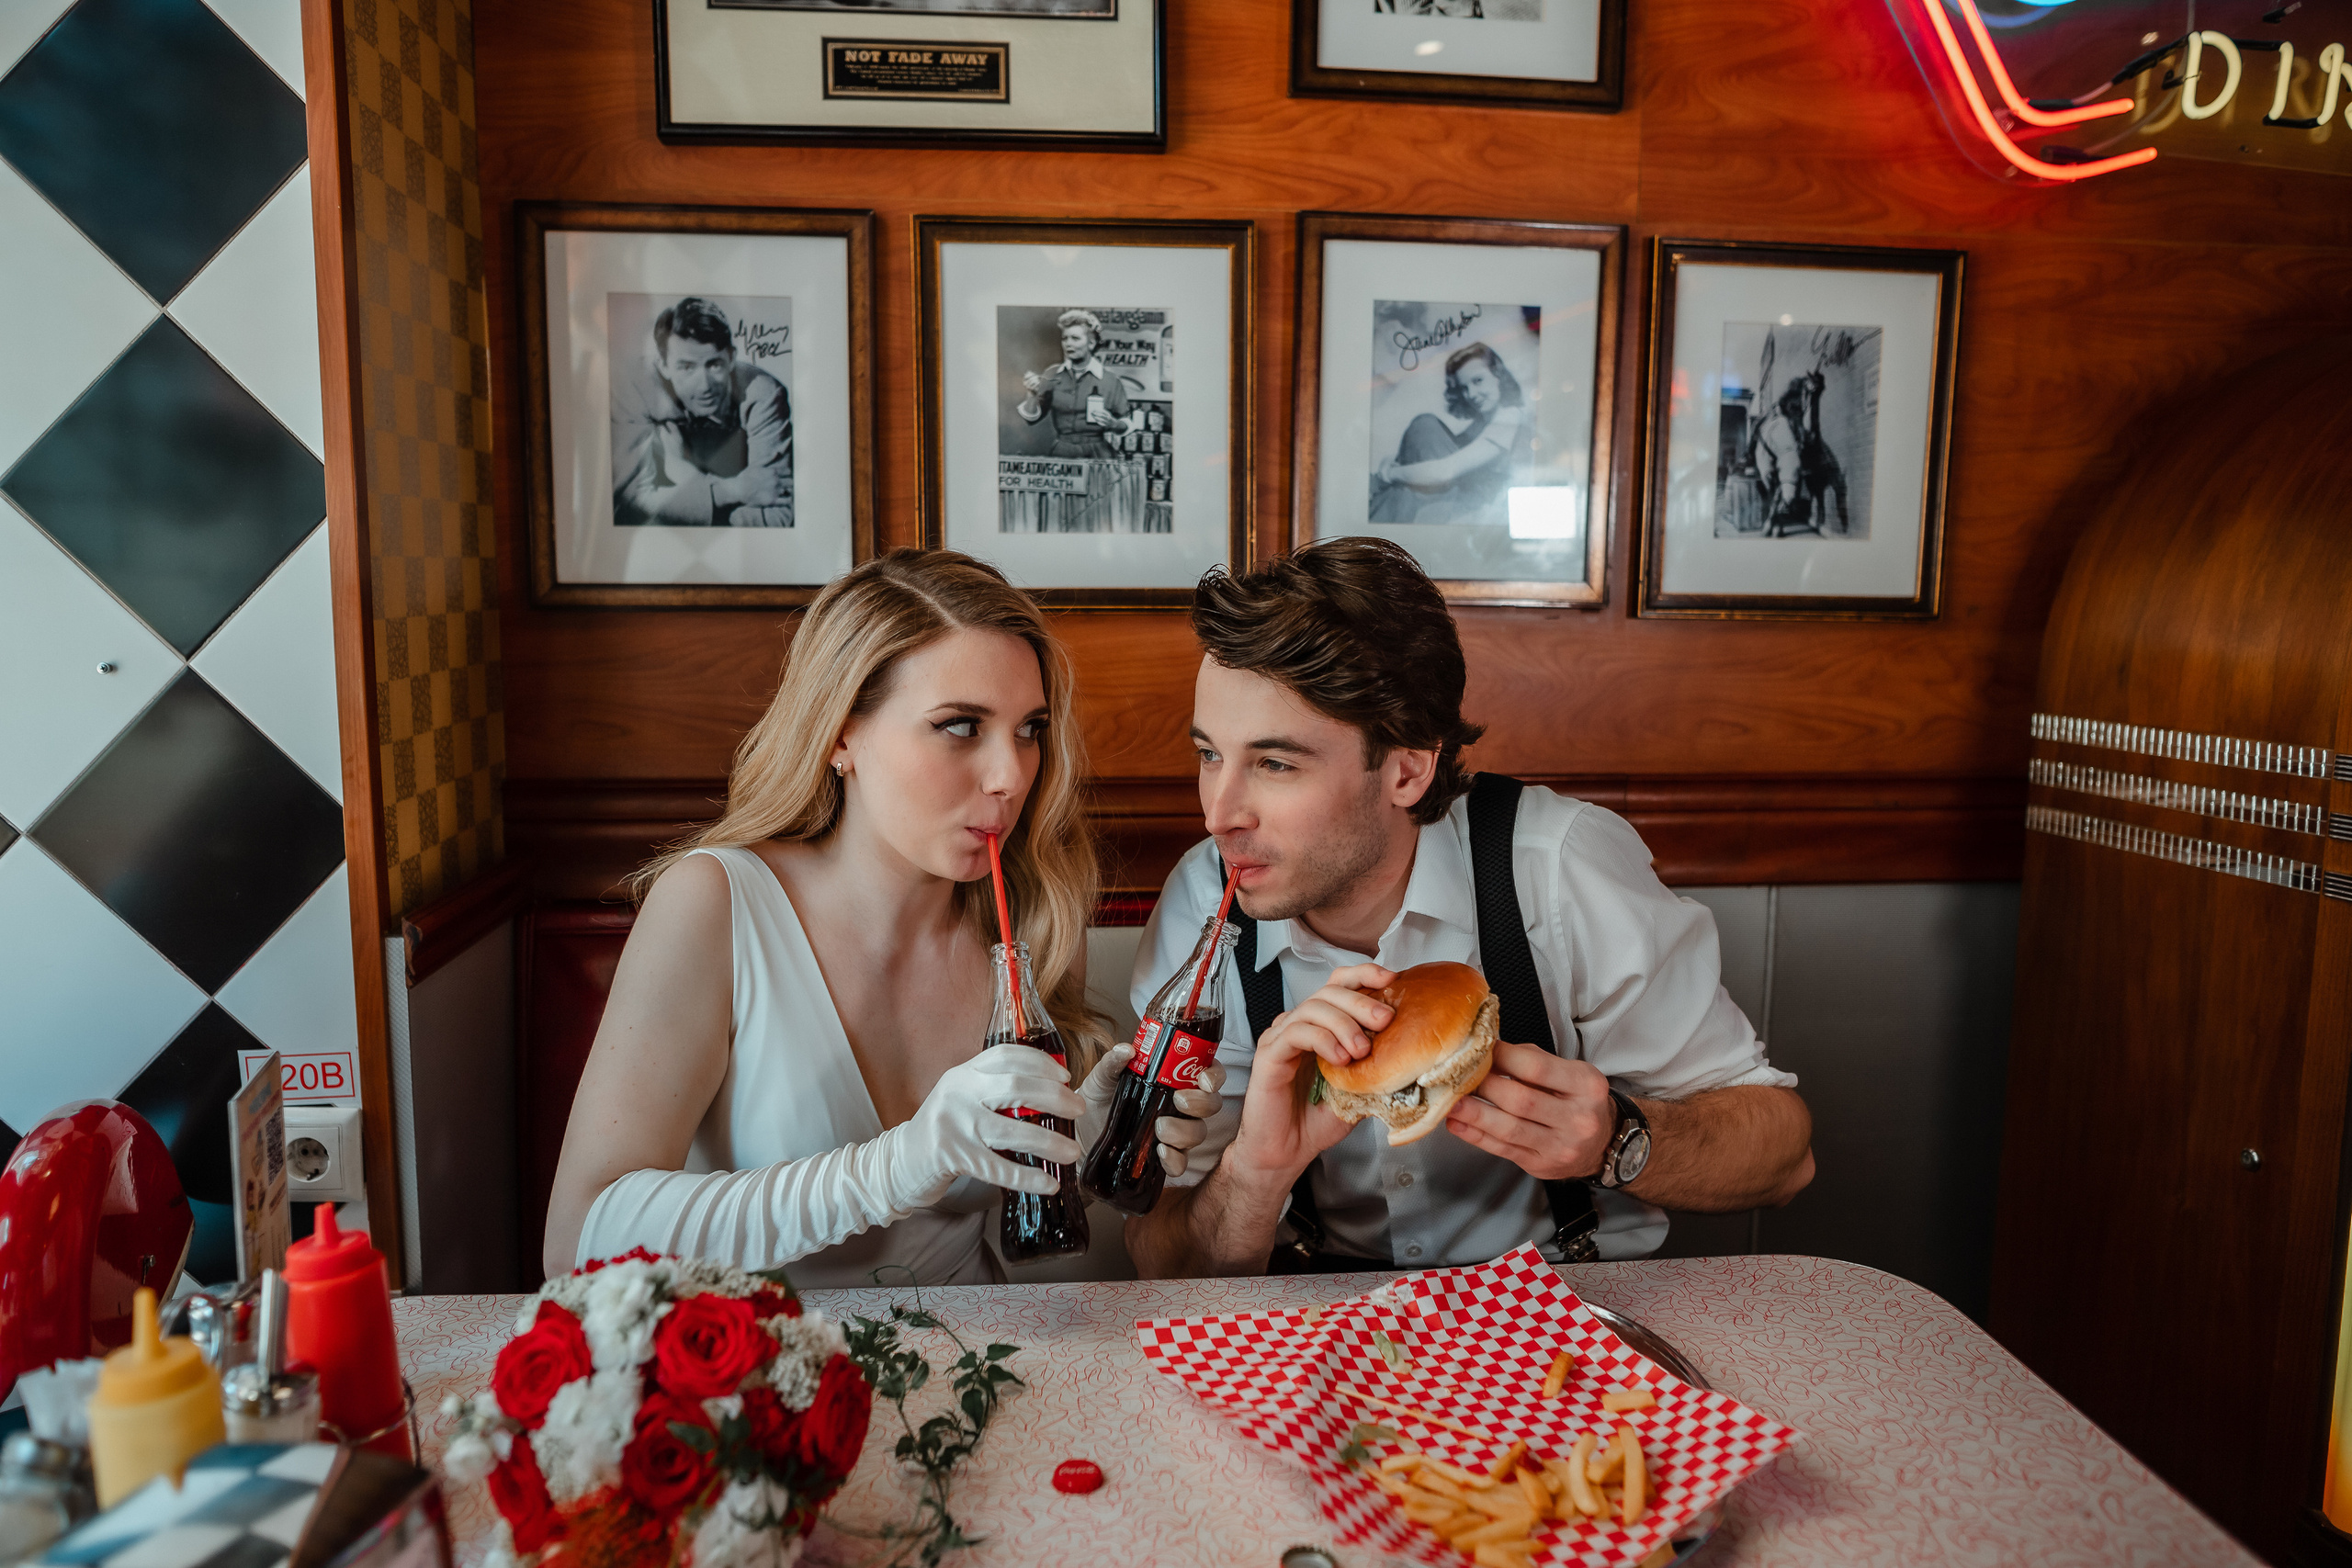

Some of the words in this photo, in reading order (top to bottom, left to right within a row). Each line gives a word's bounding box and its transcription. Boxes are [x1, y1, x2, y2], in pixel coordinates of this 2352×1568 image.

[844, 50, 882, 63] NOT
[888, 51, 933, 64] FADE
[939, 52, 989, 66] AWAY
[1103, 354, 1148, 366] HEALTH
[1000, 477, 1021, 486] FOR
[1028, 478, 1074, 489] HEALTH
[279, 1062, 345, 1091] 20B
[1172, 1056, 1208, 1086] Coc
